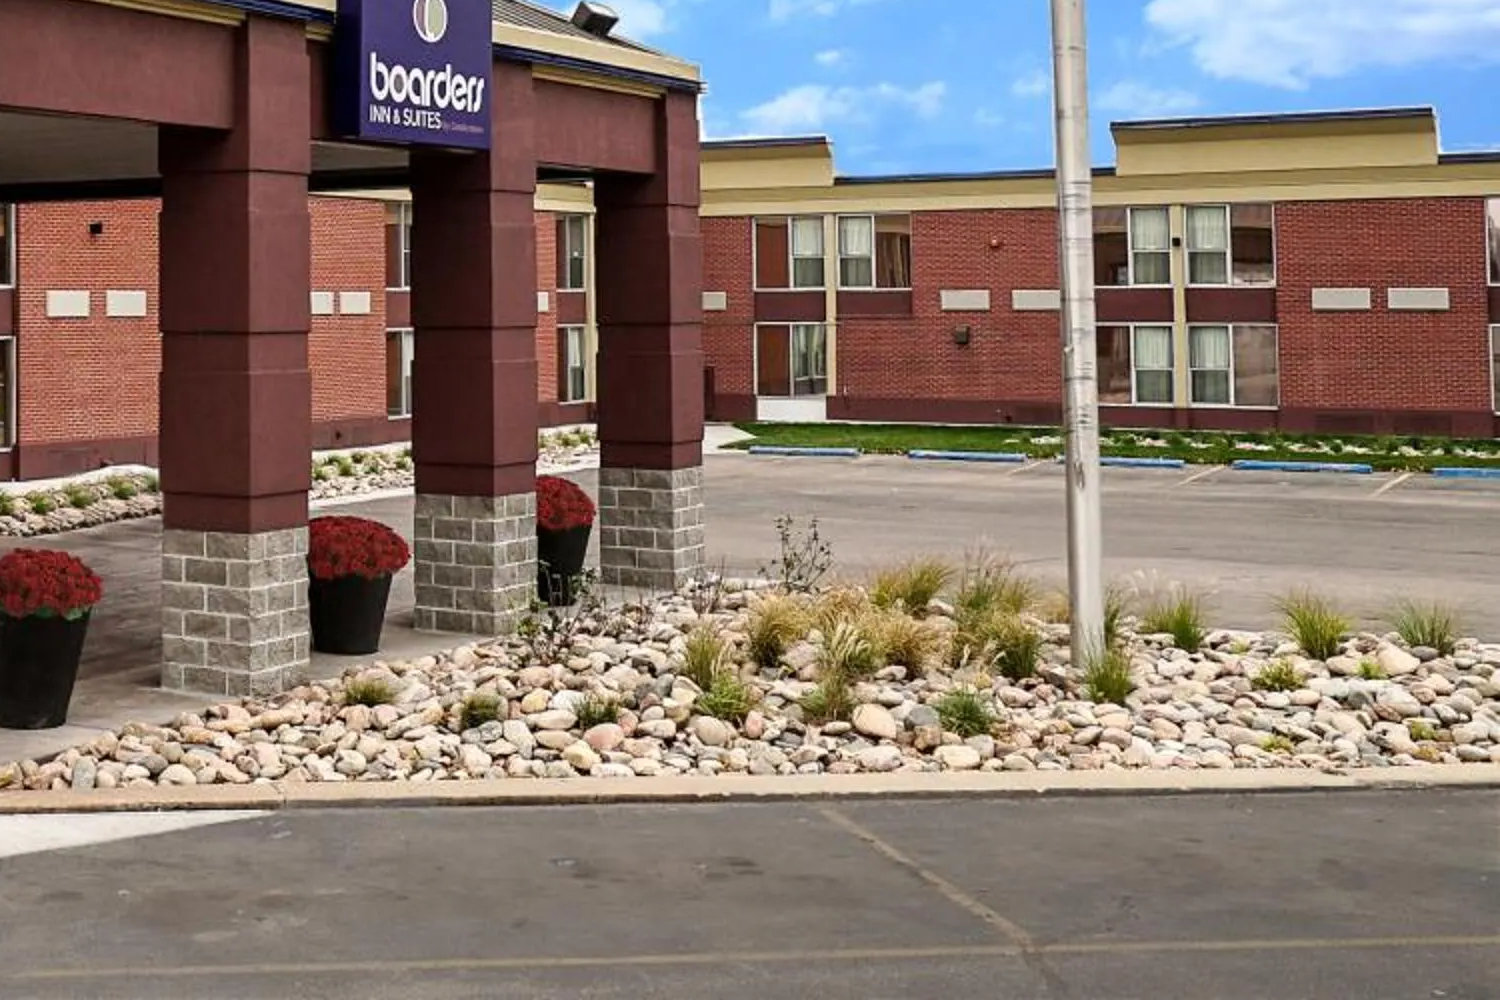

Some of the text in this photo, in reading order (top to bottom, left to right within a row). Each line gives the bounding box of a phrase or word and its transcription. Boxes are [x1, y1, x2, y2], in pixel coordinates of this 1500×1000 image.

[369, 52, 485, 113] boarders
[369, 104, 391, 124] INN
[393, 108, 401, 125] &
[403, 107, 442, 129] SUITES
